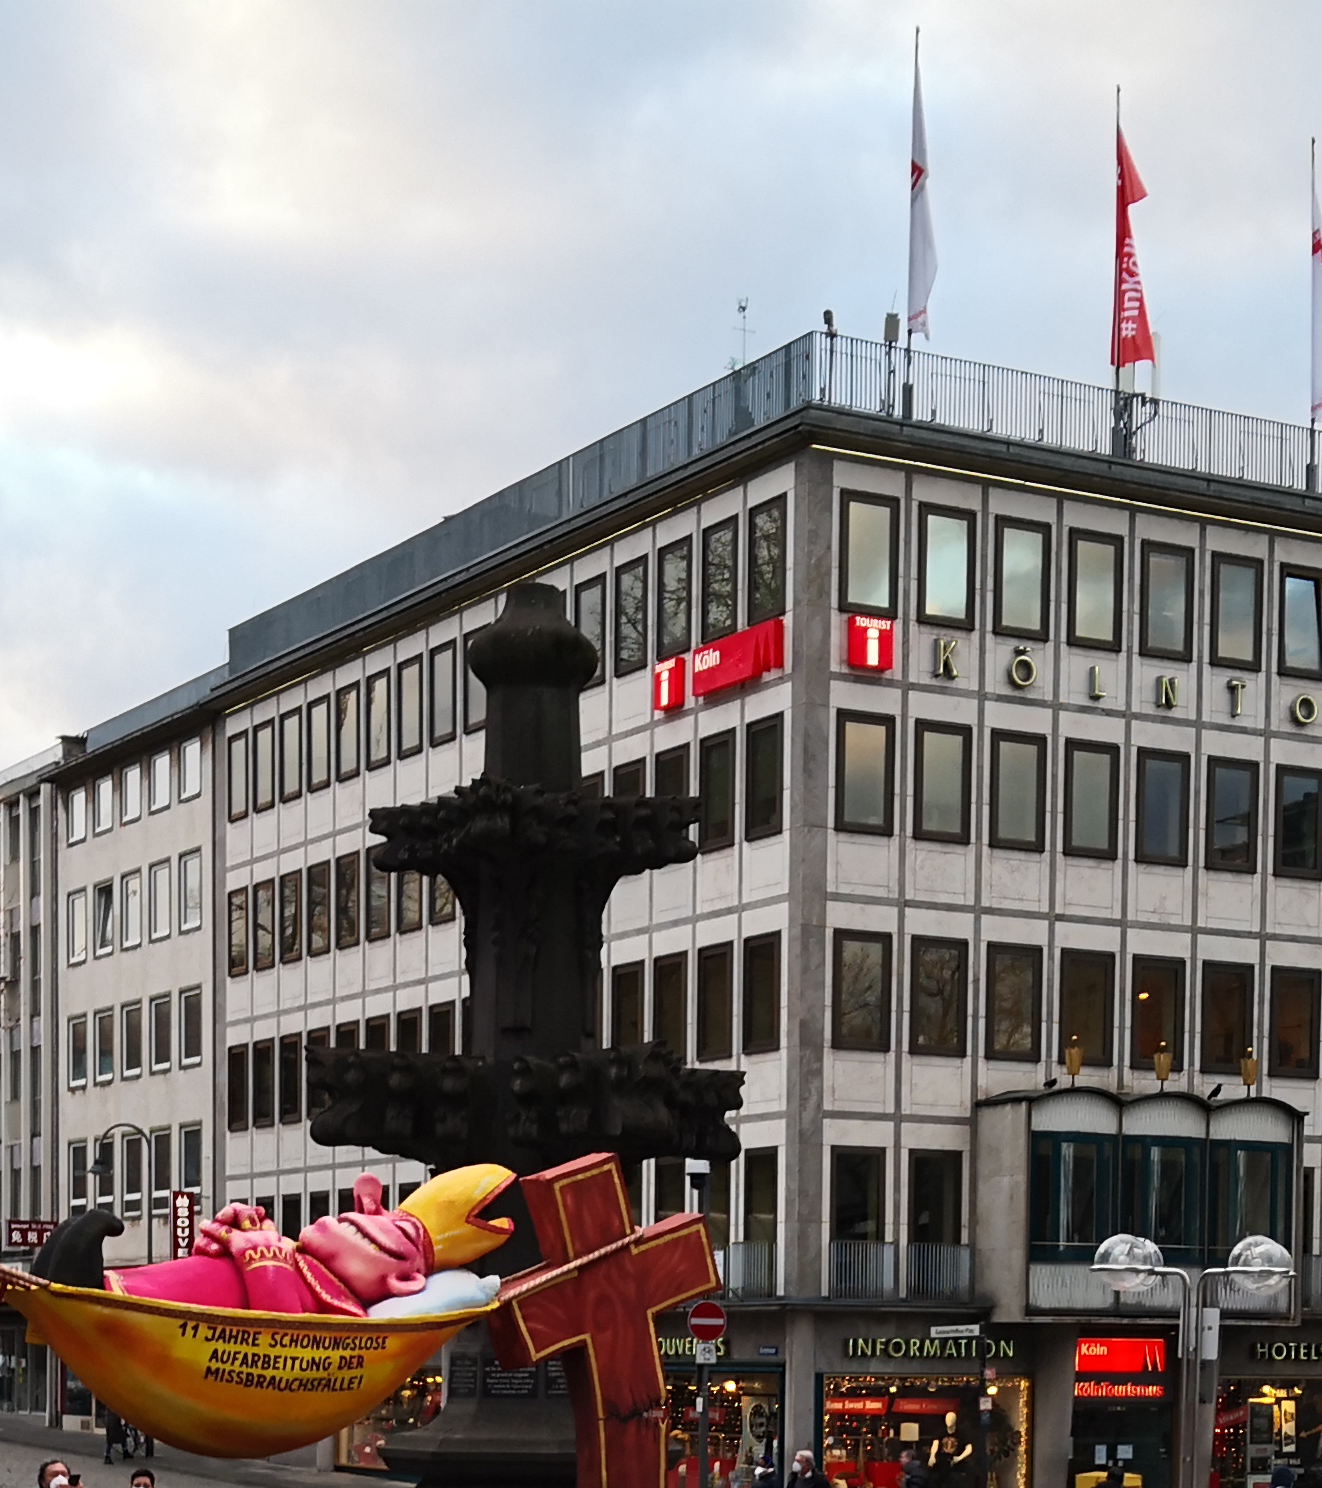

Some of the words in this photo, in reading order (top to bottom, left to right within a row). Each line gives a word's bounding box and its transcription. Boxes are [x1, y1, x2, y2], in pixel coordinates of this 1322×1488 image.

[855, 616, 891, 630] TOURIST
[694, 648, 720, 673] Köln
[176, 1207, 190, 1258] SOUVE
[178, 1321, 200, 1339] 11
[204, 1325, 262, 1348] JAHRE
[268, 1332, 389, 1352] SCHONUNGSLOSE
[848, 1337, 1015, 1358] INFORMATION
[208, 1347, 333, 1372] AUFARBEITUNG
[337, 1354, 365, 1371] DER
[1080, 1343, 1108, 1356] Köln
[203, 1365, 364, 1393] MISSBRAUCHSFÄLLE!
[1074, 1381, 1164, 1397] KölnTourismus
